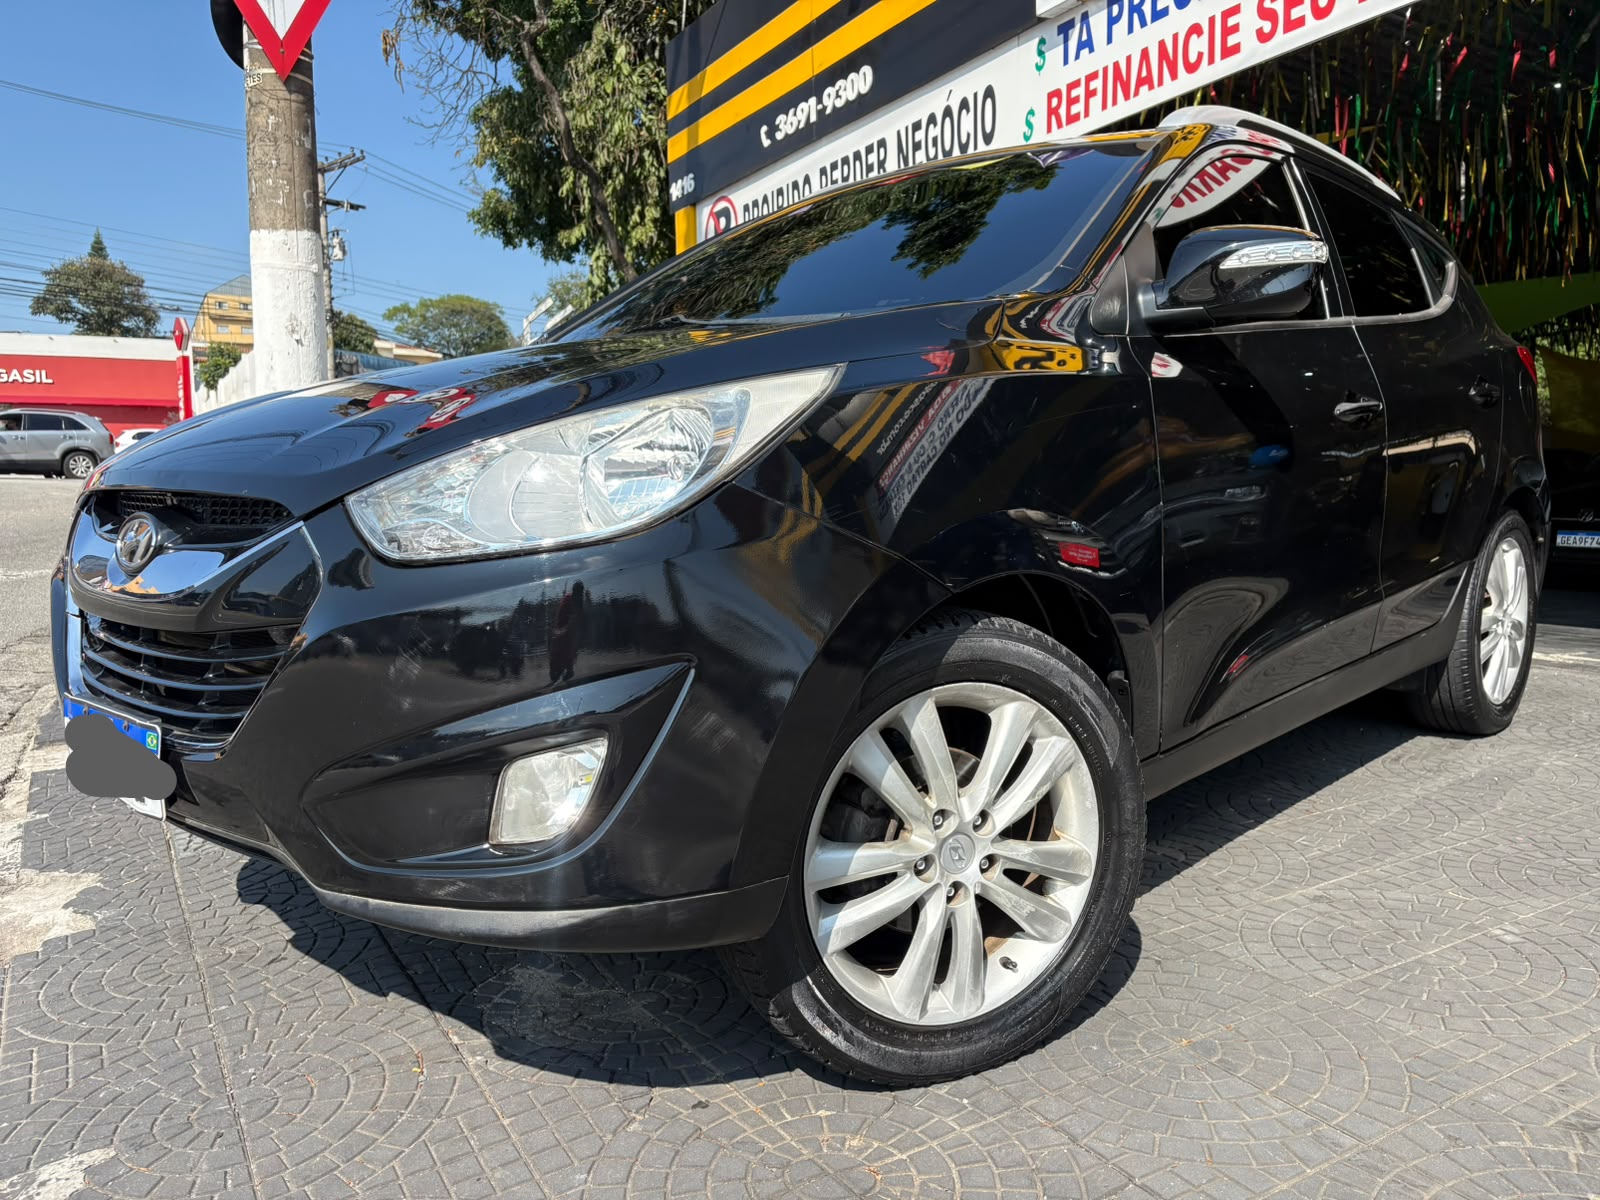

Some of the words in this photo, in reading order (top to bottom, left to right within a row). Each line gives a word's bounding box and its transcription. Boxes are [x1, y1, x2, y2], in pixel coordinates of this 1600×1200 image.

[1046, 3, 1241, 135] REFINANCIE
[1057, 10, 1095, 67] TA
[1106, 0, 1192, 46] PRE
[773, 64, 874, 142] 3691-9300
[896, 84, 997, 170] NEGÓCIO
[669, 172, 695, 202] 1416
